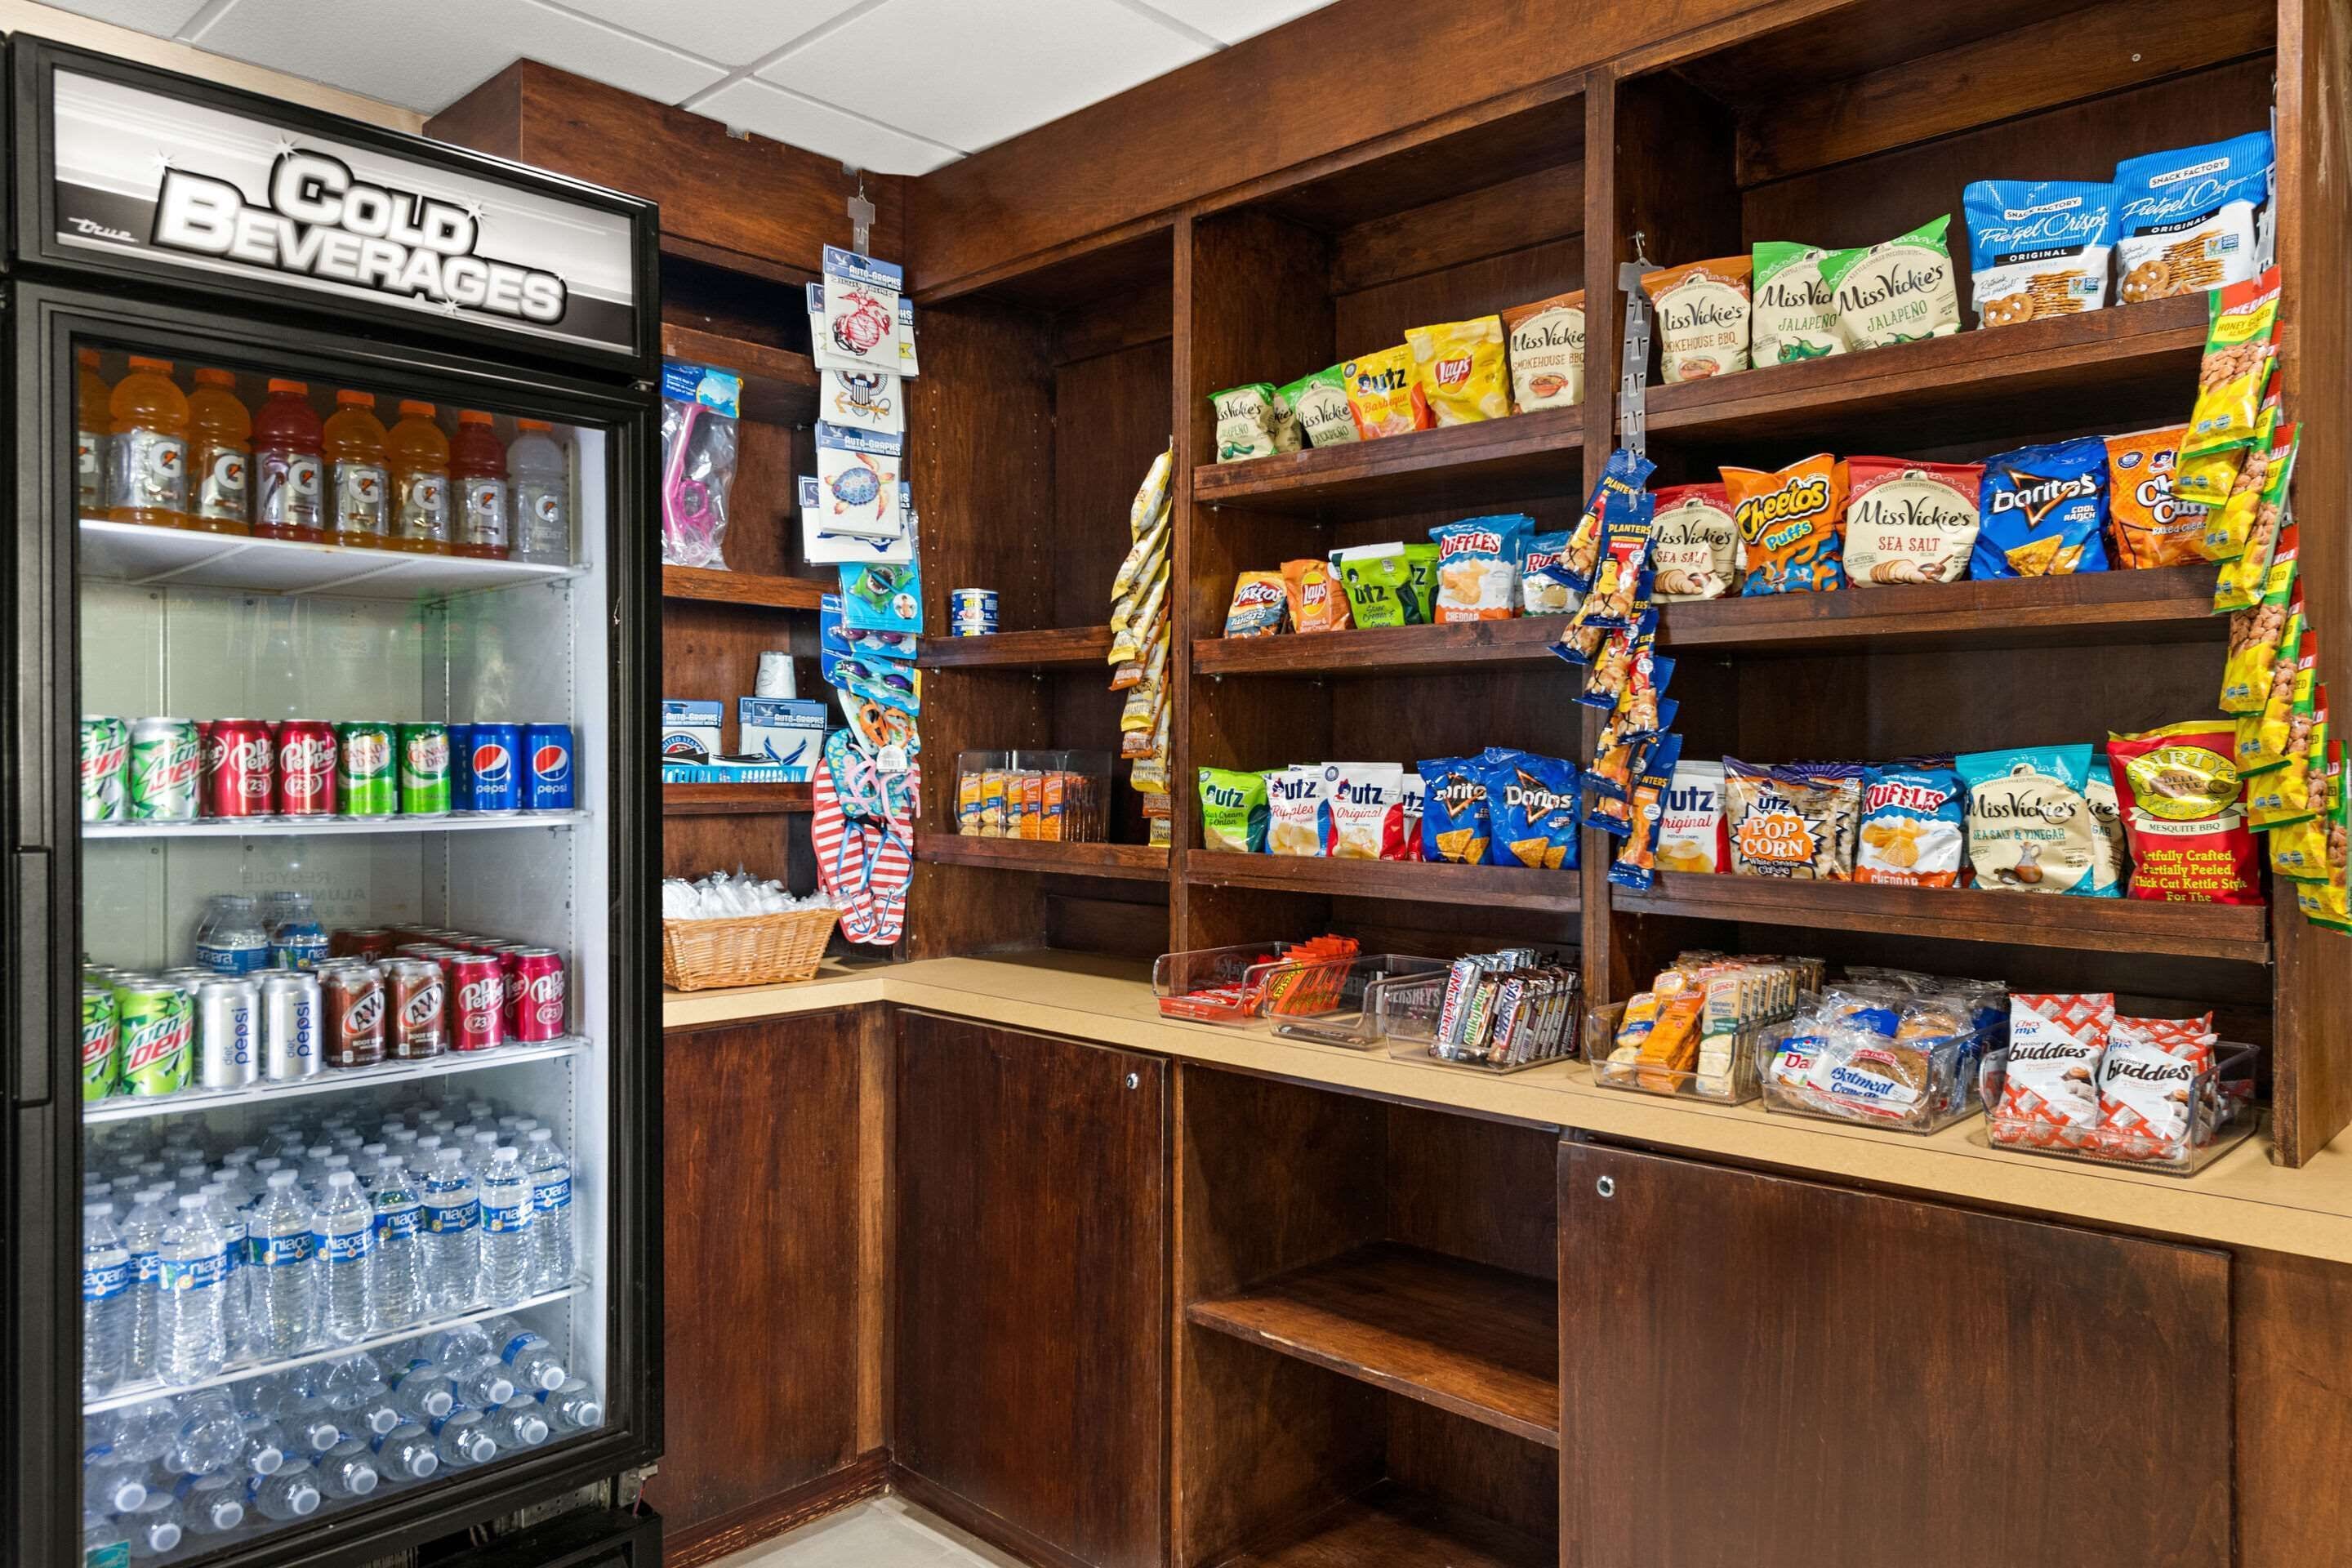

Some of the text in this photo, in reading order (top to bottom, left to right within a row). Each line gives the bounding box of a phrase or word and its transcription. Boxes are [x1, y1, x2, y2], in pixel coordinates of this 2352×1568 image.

[2150, 161, 2227, 187] SNACK FACTORY
[272, 150, 478, 252] COLD
[2007, 198, 2080, 220] SNACK FACTORY
[2150, 215, 2207, 234] ORIGINAL
[155, 170, 565, 322] BEVERAGES
[2009, 247, 2068, 262] ORIGINAL
[849, 265, 902, 287] AUTO-GRAPHS
[1758, 284, 1806, 309] Miss
[1838, 286, 1885, 316] Miss
[1875, 263, 1944, 297] Vickie's
[1686, 296, 1744, 327] Vickie's
[1867, 300, 1928, 333] JALAPEÑO
[1778, 314, 1837, 332] JALAPEÑO
[1511, 320, 1585, 353] Miss Vickie
[1717, 332, 1739, 346] BBQ
[1439, 354, 1473, 384] Lay's
[1512, 354, 1566, 373] SMOKEHOUSE
[1372, 368, 1407, 391] utz
[1217, 409, 1228, 421] iss
[1316, 399, 1352, 423] Vickie'
[844, 435, 901, 452] AUTO-GRAPHS
[1602, 476, 1640, 497] PLANTER
[1993, 474, 2098, 514] Doritos
[1735, 479, 1826, 542] Cheetos
[1854, 497, 1973, 534] Miss Vickie's
[2063, 512, 2096, 522] RANCH
[2071, 506, 2096, 514] COOL
[1608, 523, 1652, 536] PLANTERS
[1680, 519, 1733, 551] Vickie's
[1765, 520, 1813, 551] Puffs
[1439, 532, 1502, 561] RUFFLES
[1878, 537, 1940, 552] SEA SALT
[1656, 550, 1677, 564] SEA
[1233, 581, 1284, 607] Fritos
[1302, 580, 1327, 605] Lay's
[666, 713, 718, 722] AUTO-GRAPHS
[773, 714, 825, 724] AUTO-GRAPHS
[304, 737, 328, 758] Dr
[662, 736, 683, 751] NITED
[355, 755, 381, 768] DRY
[475, 783, 508, 795] pepsi
[537, 782, 568, 795] pepsi
[1284, 778, 1317, 800] utz
[1433, 783, 1487, 801] Dorito
[1642, 774, 1668, 789] NTERS
[1214, 788, 1245, 808] utz
[1351, 783, 1383, 805] utz
[1668, 786, 1715, 812] utz
[1757, 795, 1791, 812] utz
[1861, 782, 1946, 816] RUFFLES
[1336, 807, 1383, 823] Original
[2007, 789, 2077, 825] Vickie's
[1749, 818, 1797, 840] POP
[1973, 828, 2066, 840] SEA SALT & VINEGAR
[2149, 822, 2221, 832] MESQUITE BBQ
[1742, 838, 1805, 858] CORN
[2186, 849, 2236, 862] Crafted,
[2142, 863, 2235, 879] Partially Peeled,
[2135, 876, 2158, 888] Thick
[2159, 879, 2180, 889] Cut
[2183, 878, 2220, 889] Kettle
[2166, 892, 2212, 902] For The
[1438, 974, 1463, 1041] Musketeer
[231, 1007, 249, 1065] pepsi
[293, 1000, 314, 1058] pepsi
[2015, 1027, 2038, 1036] mix
[2008, 1042, 2091, 1062] buddies
[1830, 1067, 1895, 1095] Oatmeal
[2107, 1059, 2191, 1082] buddies
